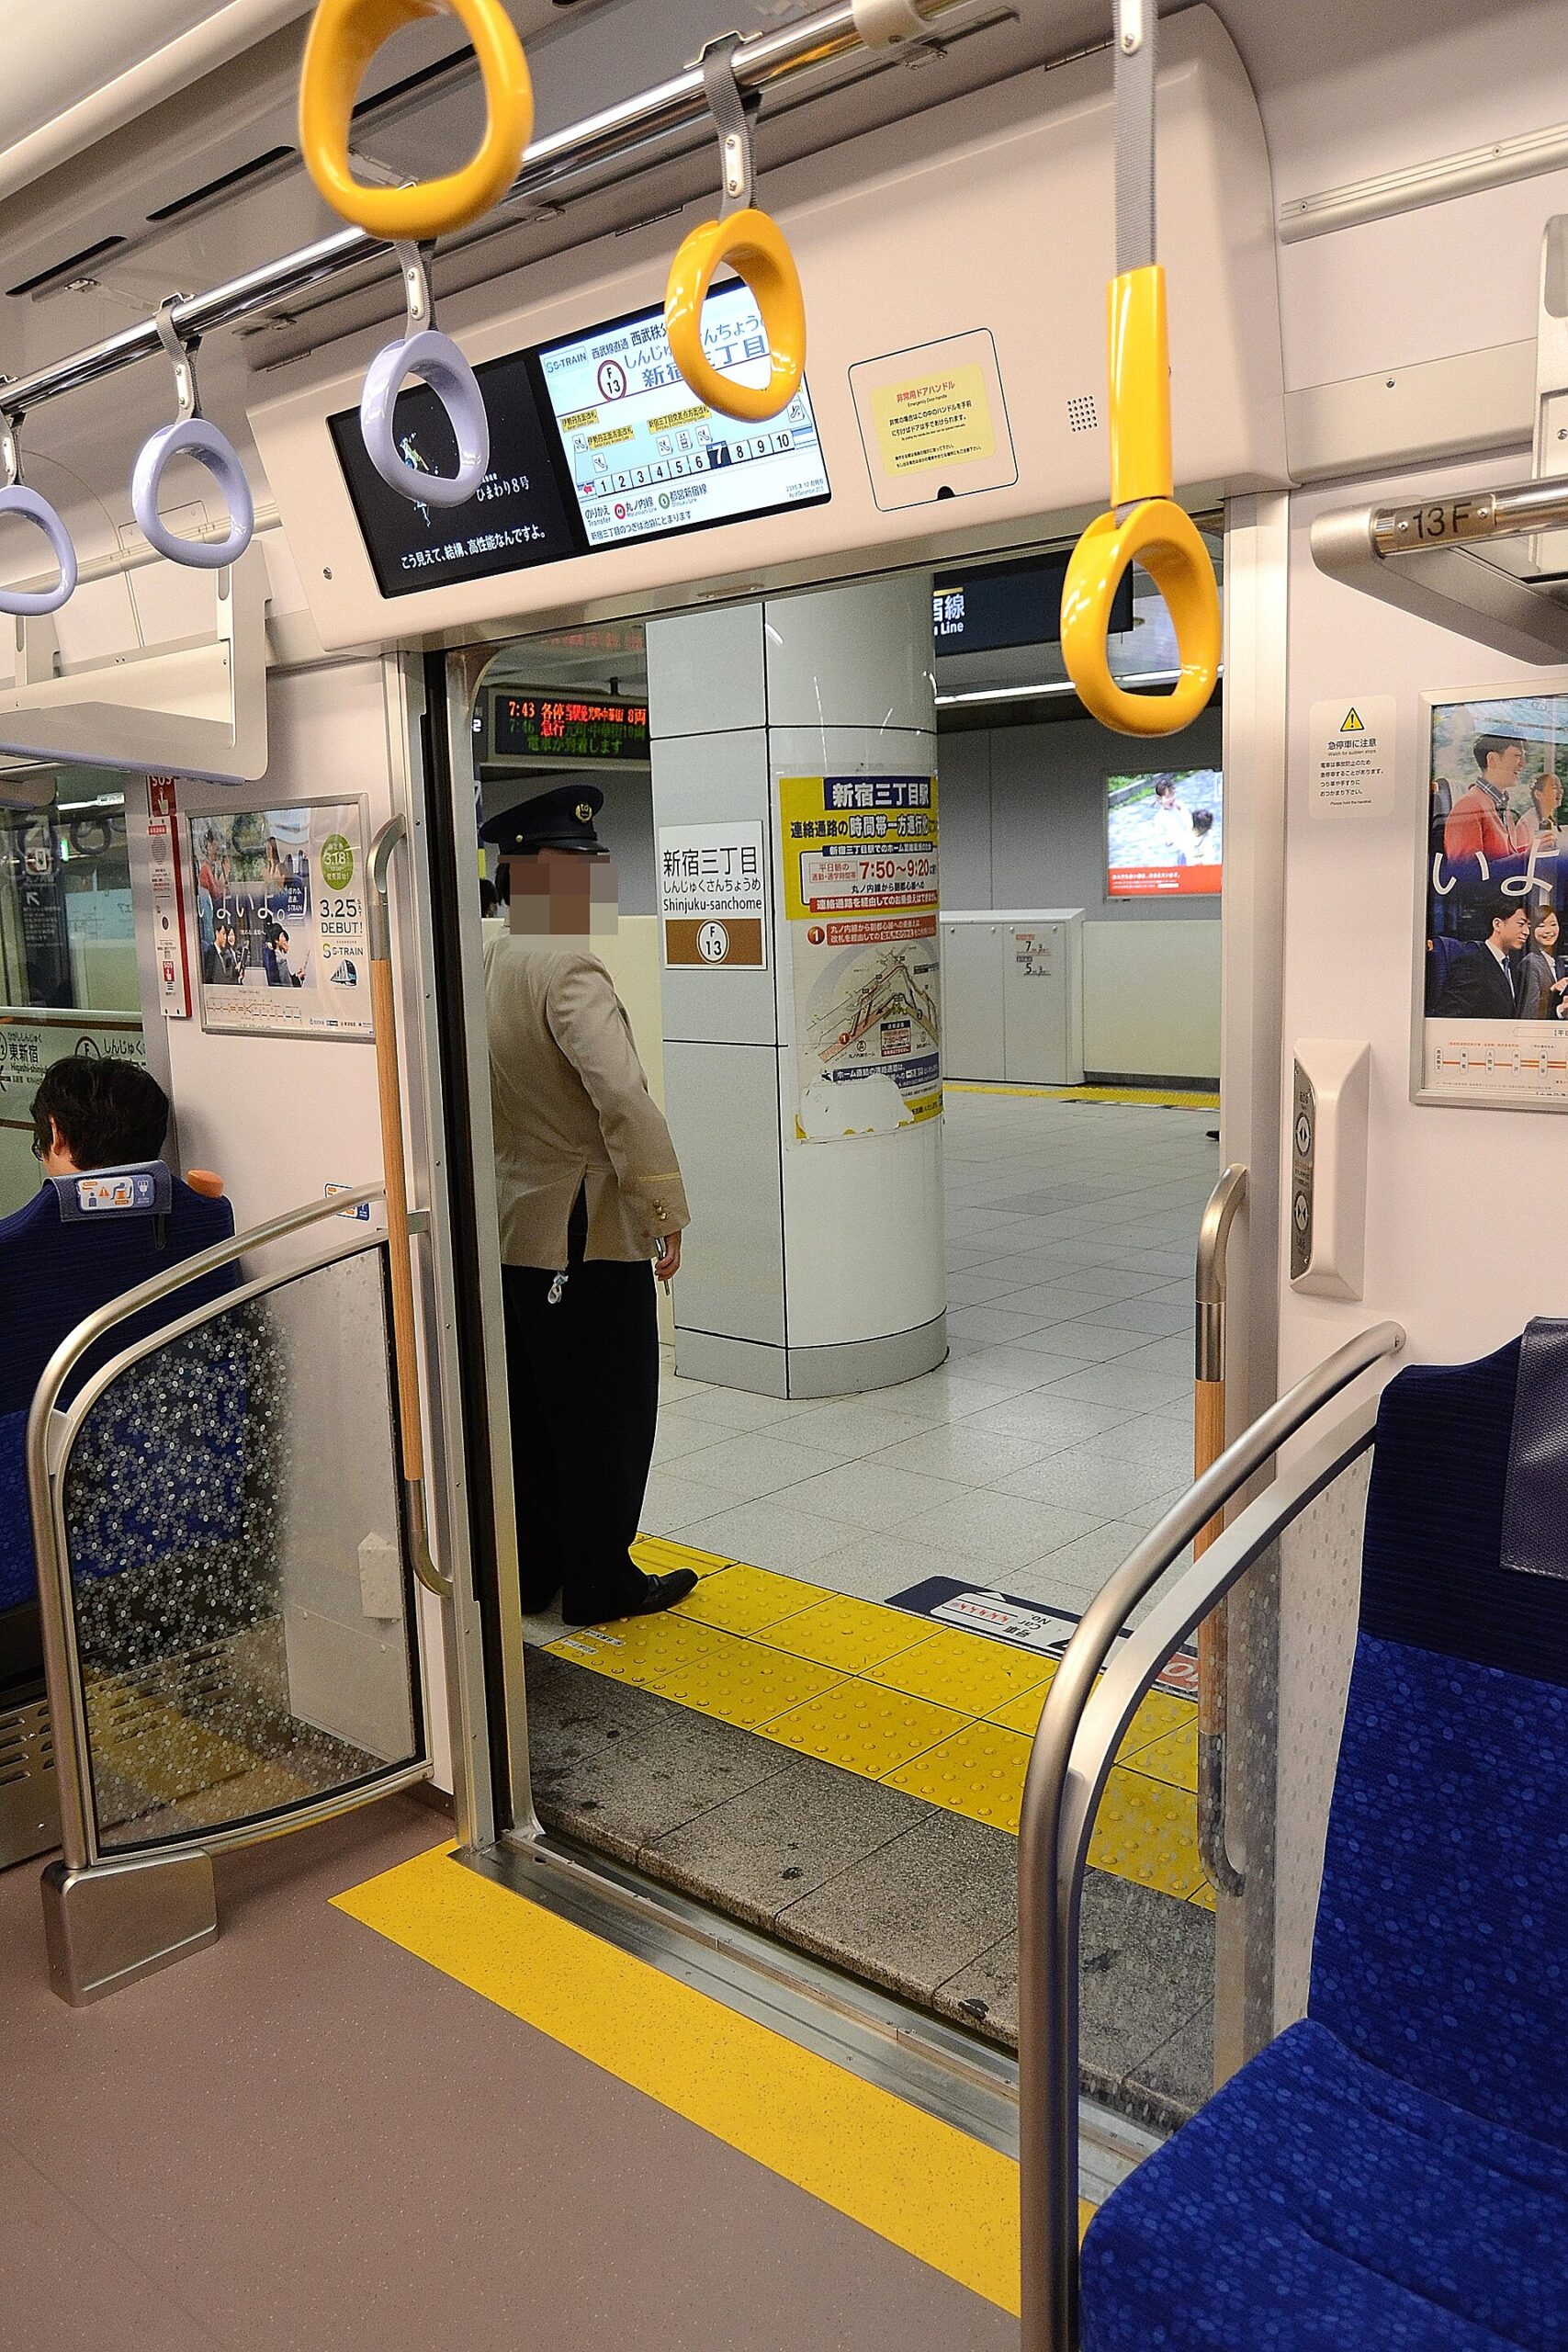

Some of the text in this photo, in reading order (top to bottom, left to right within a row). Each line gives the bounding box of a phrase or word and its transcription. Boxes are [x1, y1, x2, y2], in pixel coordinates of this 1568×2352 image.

[607, 368, 613, 379] F
[607, 379, 621, 394] 13
[897, 380, 954, 402] 非常用ドアハンドル
[757, 439, 765, 453] 9
[776, 434, 790, 448] 10
[712, 444, 723, 466] 7
[736, 446, 744, 458] 8
[676, 460, 683, 473] 5
[695, 456, 703, 469] 6
[637, 470, 645, 483] 3
[657, 466, 663, 479] 4
[476, 475, 529, 503] ひまわり8号
[601, 480, 607, 492] 1
[619, 475, 626, 488] 2
[670, 483, 708, 501] 都営新宿線
[626, 496, 654, 513] 丸ノ内線
[584, 505, 611, 520] のりかえ
[1412, 502, 1473, 539] 13F
[401, 524, 546, 570] こう見えて、結構、高性能なんですよ。
[940, 621, 964, 635] Line
[509, 701, 536, 718] 7:43
[541, 703, 565, 720] 各停
[1327, 738, 1377, 751] 急停車に注意
[832, 783, 929, 808] 新宿三丁目駅
[663, 846, 757, 877] 新宿三丁目
[663, 877, 761, 894] しんじゅくさんちょうめ
[321, 899, 357, 918] 3.25
[663, 896, 762, 914] Shinjuku-sanchome
[321, 922, 363, 934] DEBUT!
[710, 926, 716, 937] F
[705, 941, 722, 956] 13
[9, 1044, 39, 1063] 東新宿
[103, 1038, 145, 1055] しんじゅく
[1018, 1620, 1042, 1630] Car
[1031, 1614, 1052, 1625] No.
[1002, 1625, 1031, 1638] 号車
